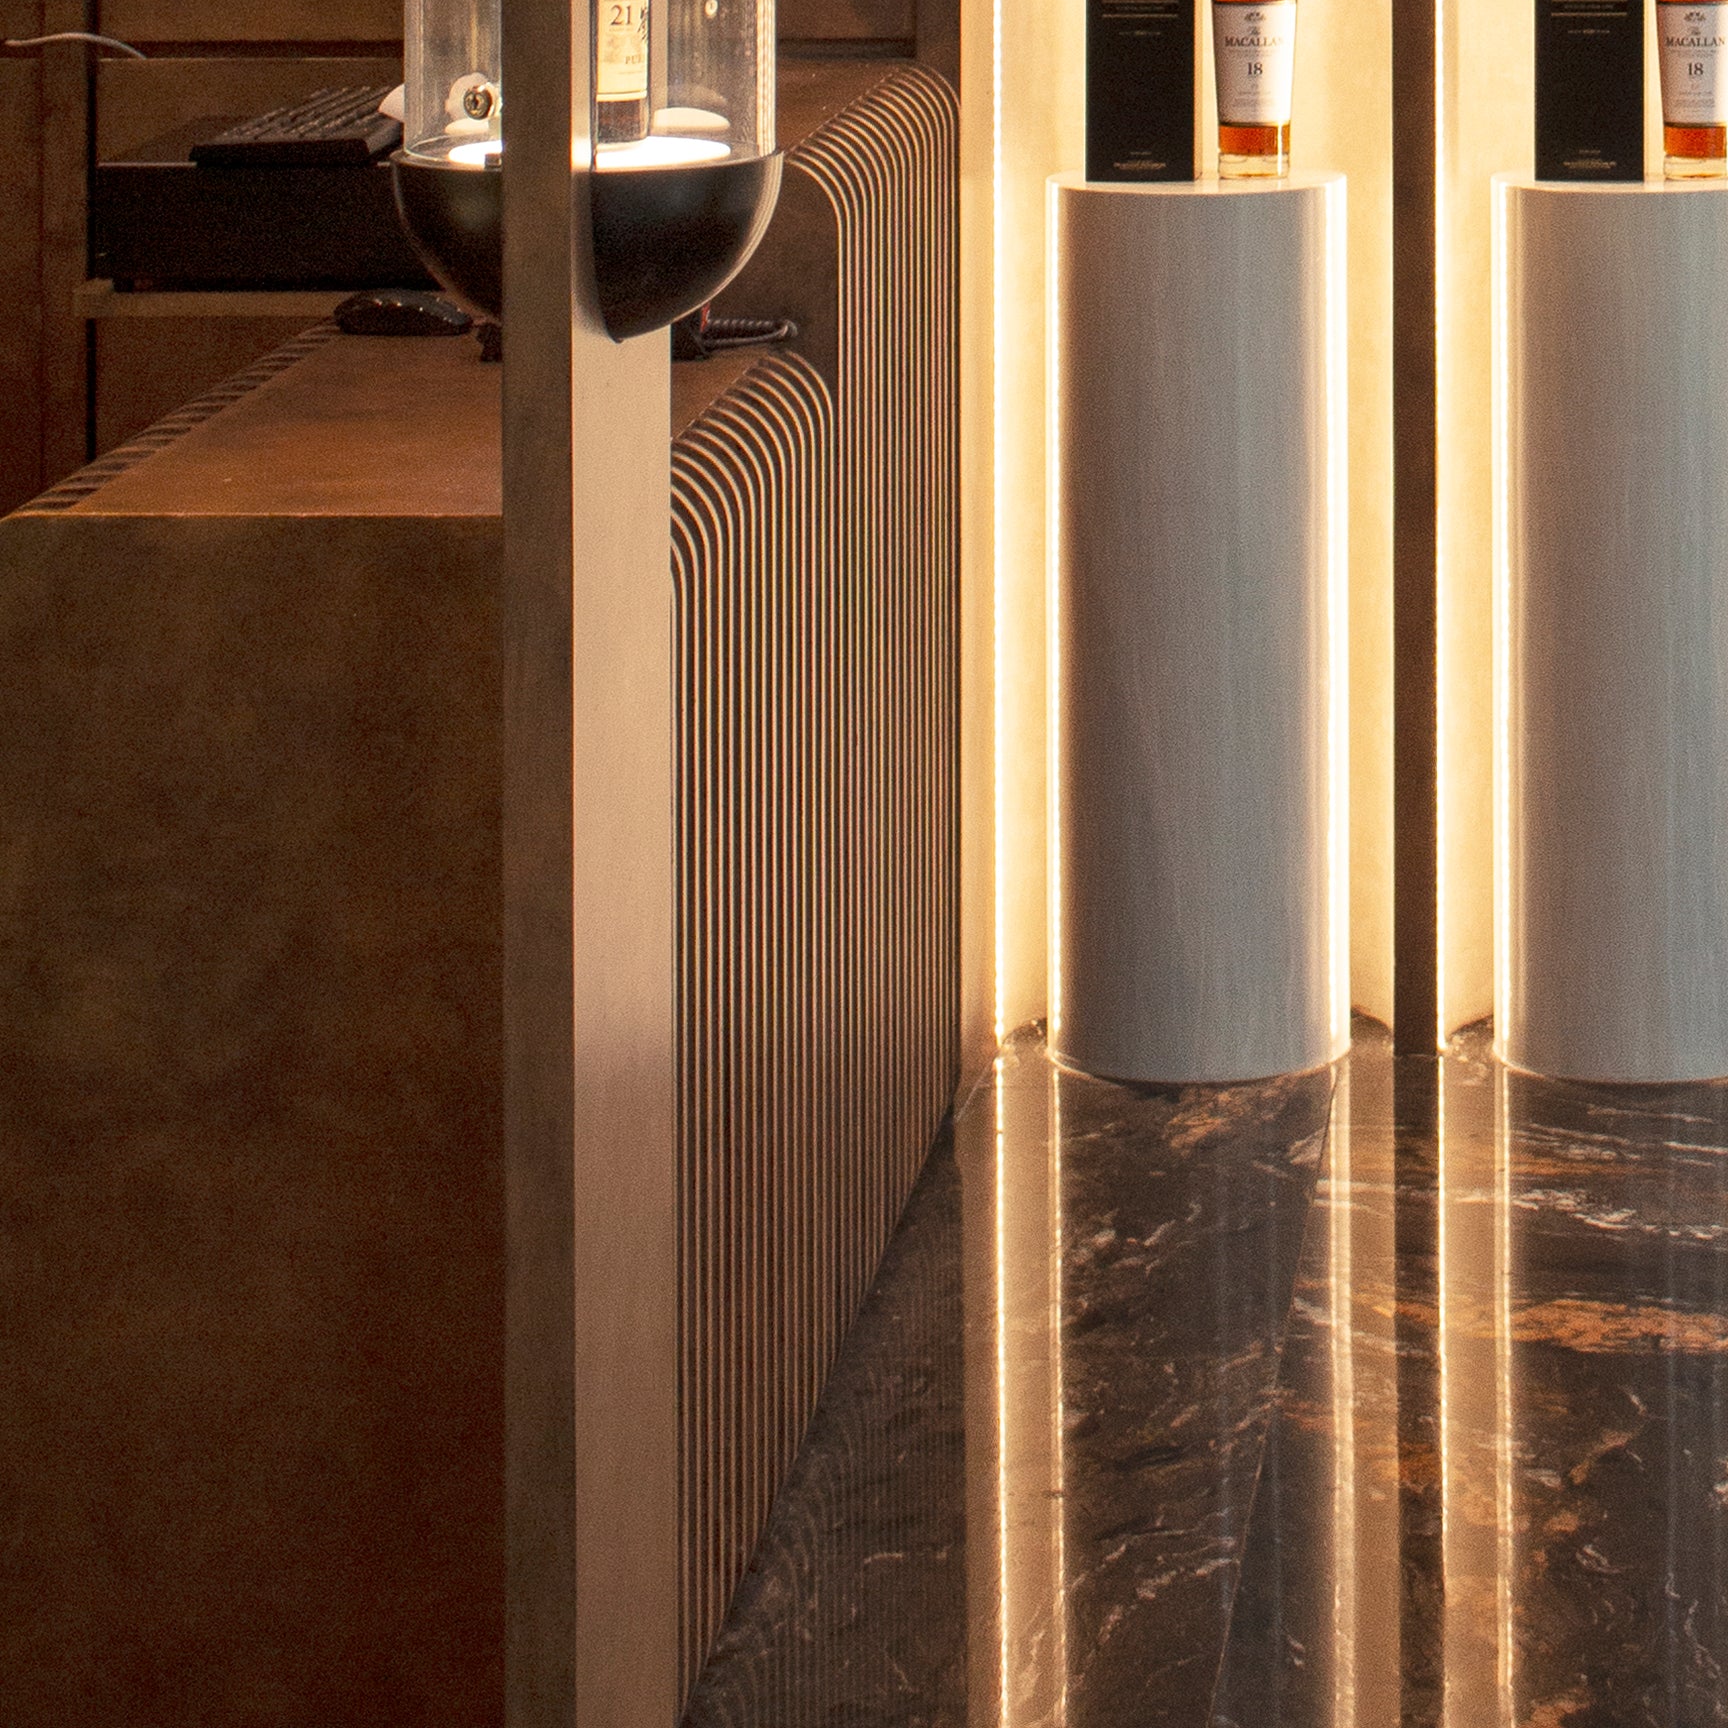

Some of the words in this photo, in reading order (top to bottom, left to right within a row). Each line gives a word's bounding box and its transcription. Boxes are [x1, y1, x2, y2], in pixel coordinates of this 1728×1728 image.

[610, 5, 632, 26] 21
[1665, 36, 1726, 48] MACALLAN
[1247, 62, 1263, 76] 18
[1687, 62, 1704, 76] 18
